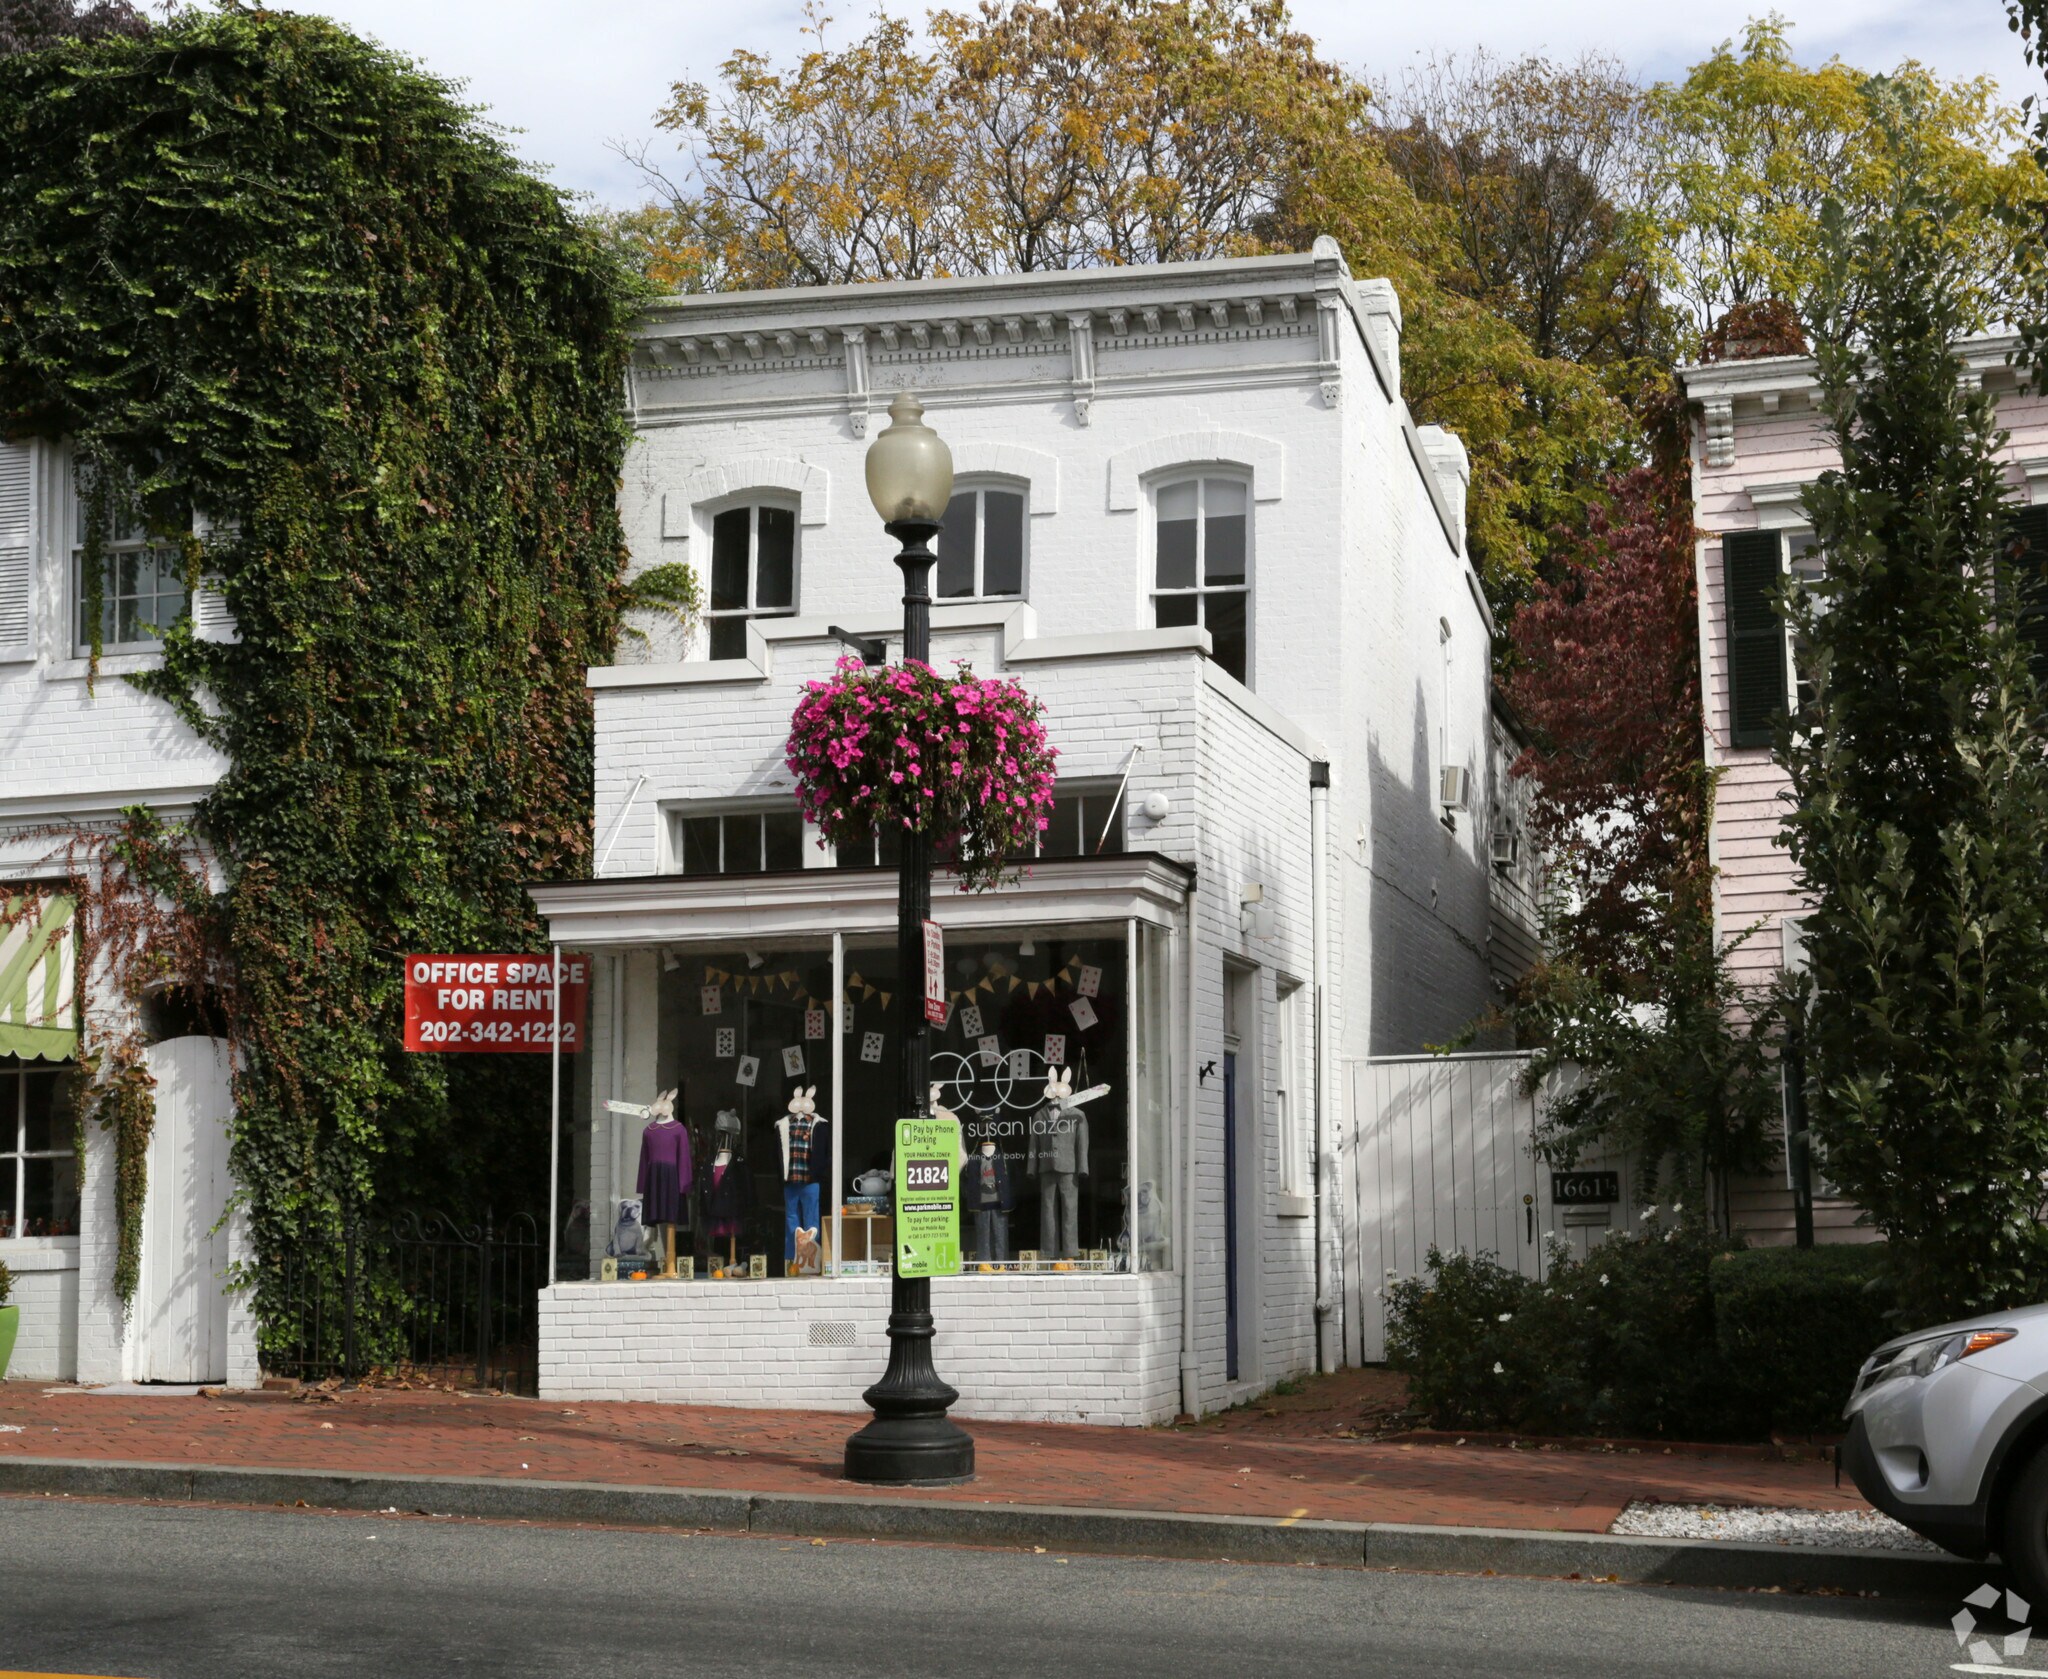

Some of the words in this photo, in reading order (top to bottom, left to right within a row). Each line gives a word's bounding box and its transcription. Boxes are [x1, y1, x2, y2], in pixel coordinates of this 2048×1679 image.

[413, 962, 499, 984] OFFICE
[506, 963, 585, 984] SPACE
[438, 989, 485, 1010] FOR
[493, 989, 556, 1010] RENT
[420, 1021, 576, 1043] 202-342-1222
[913, 1125, 924, 1135] Pay
[926, 1125, 934, 1135] by
[935, 1125, 954, 1134] Phone
[967, 1121, 1024, 1138] susan
[1029, 1116, 1078, 1135] lazar
[913, 1135, 937, 1145] Parking
[1003, 1152, 1026, 1161] baby
[1038, 1150, 1059, 1159] child
[907, 1166, 949, 1184] 21824
[904, 1203, 952, 1212] www.parkmobile.com
